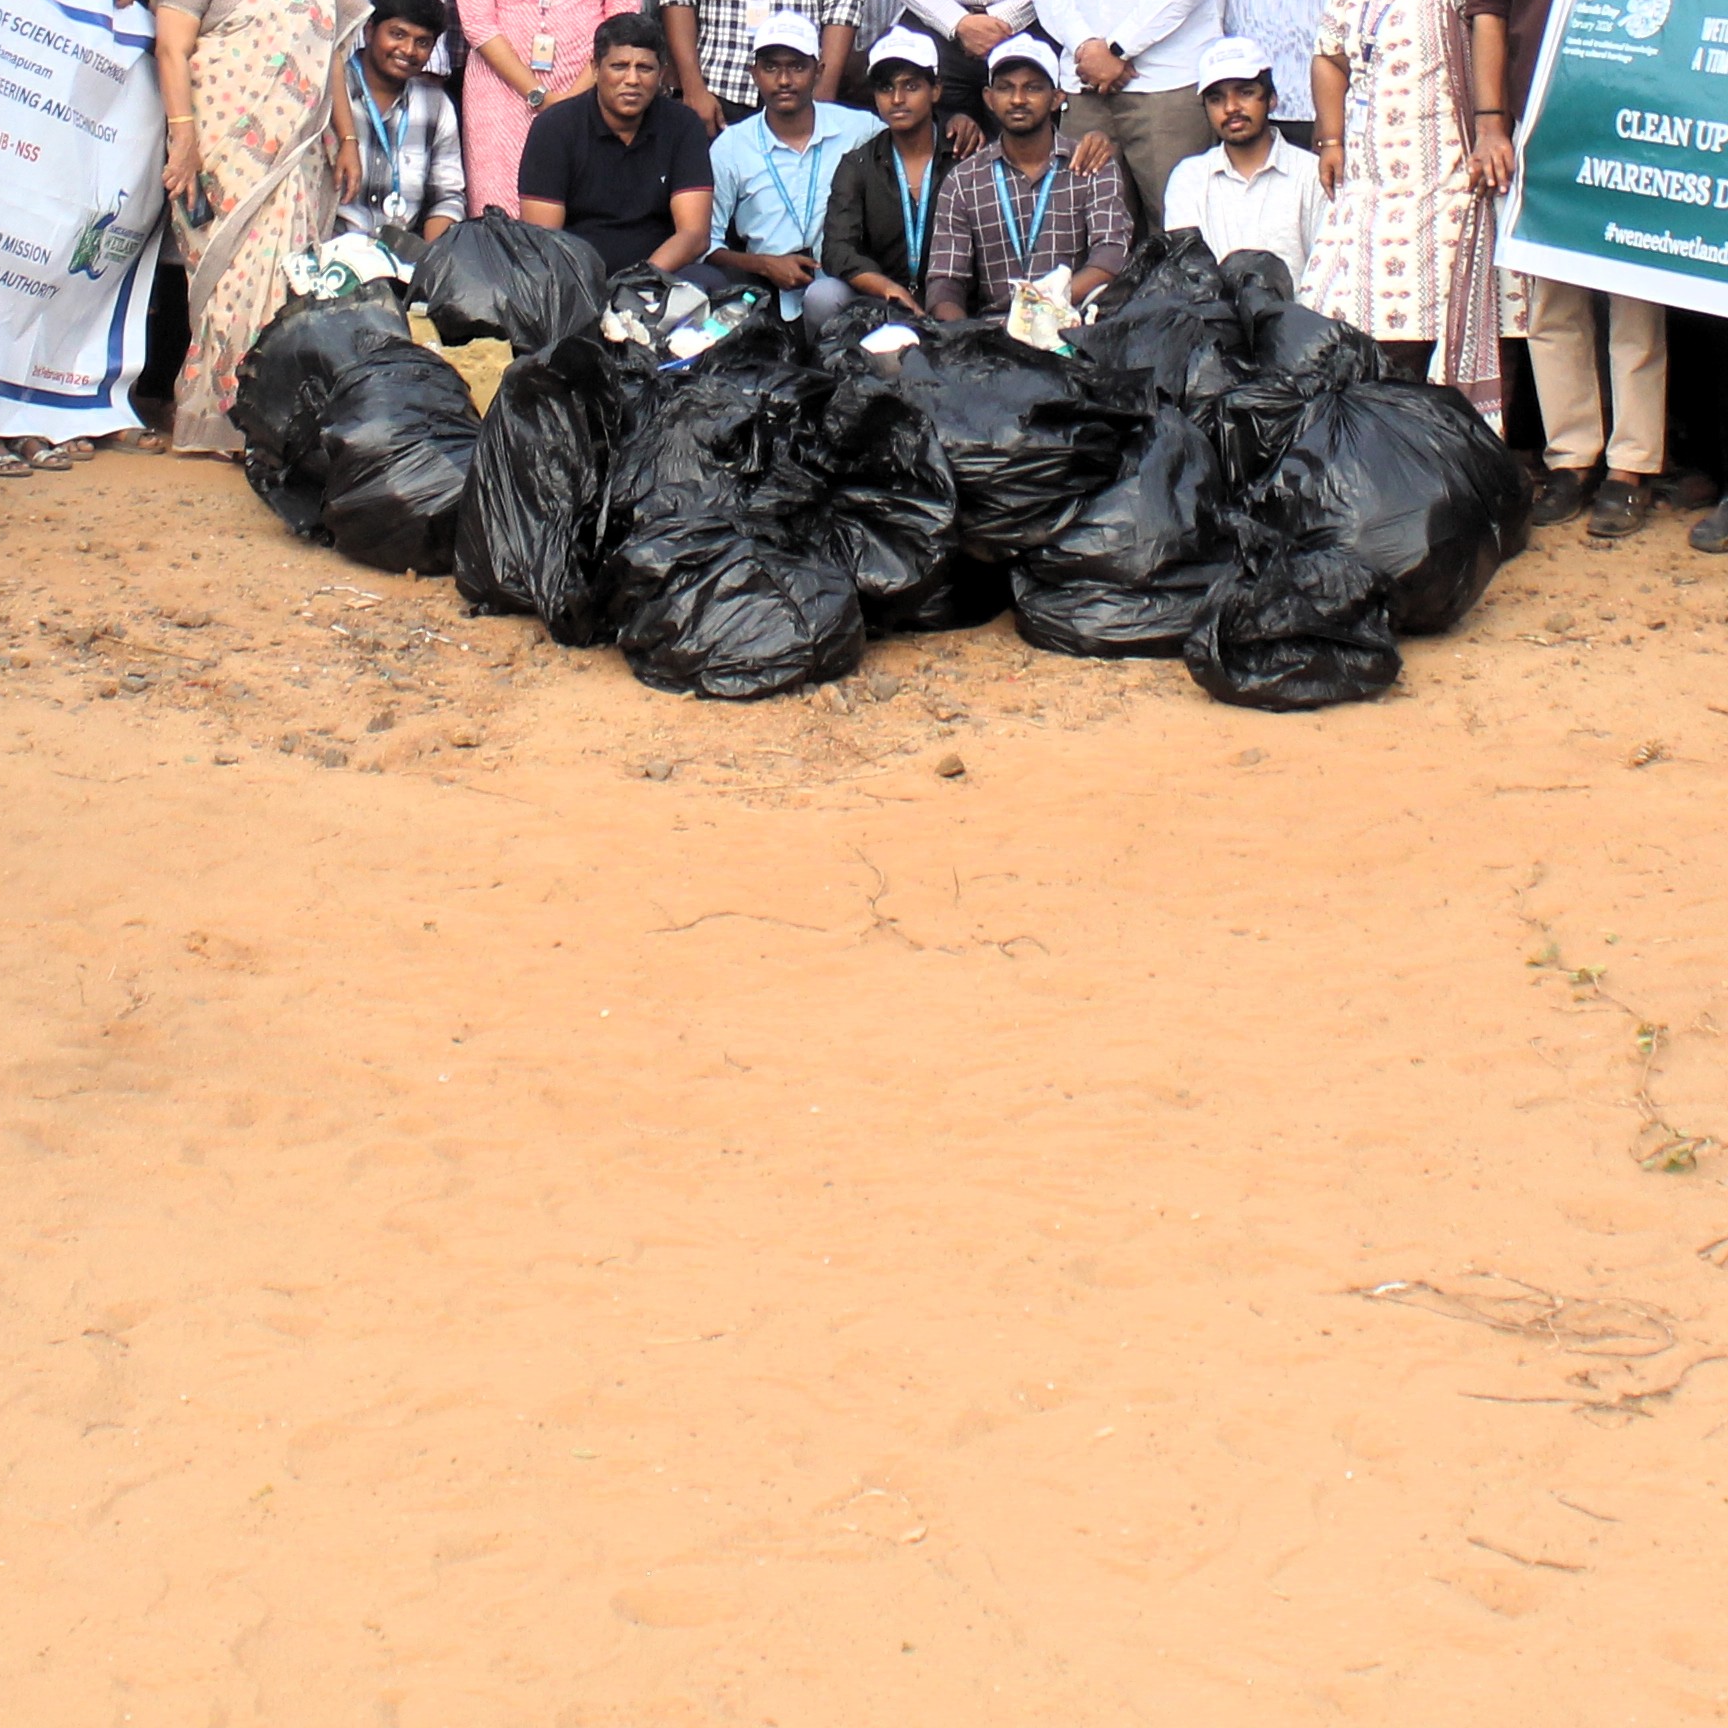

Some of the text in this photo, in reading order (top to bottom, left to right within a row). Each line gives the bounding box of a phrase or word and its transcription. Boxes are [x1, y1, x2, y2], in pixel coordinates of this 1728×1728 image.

[10, 16, 73, 54] SCIENCE
[71, 42, 93, 65] AND
[1691, 47, 1704, 71] A
[40, 99, 72, 122] AND
[71, 109, 118, 144] TECHNOLOGY
[1616, 108, 1693, 148] CLEAN
[15, 139, 41, 162] NSS
[1575, 155, 1712, 207] AWARENESS
[1, 235, 53, 266] MISSION
[1, 271, 61, 300] AUTHORITY
